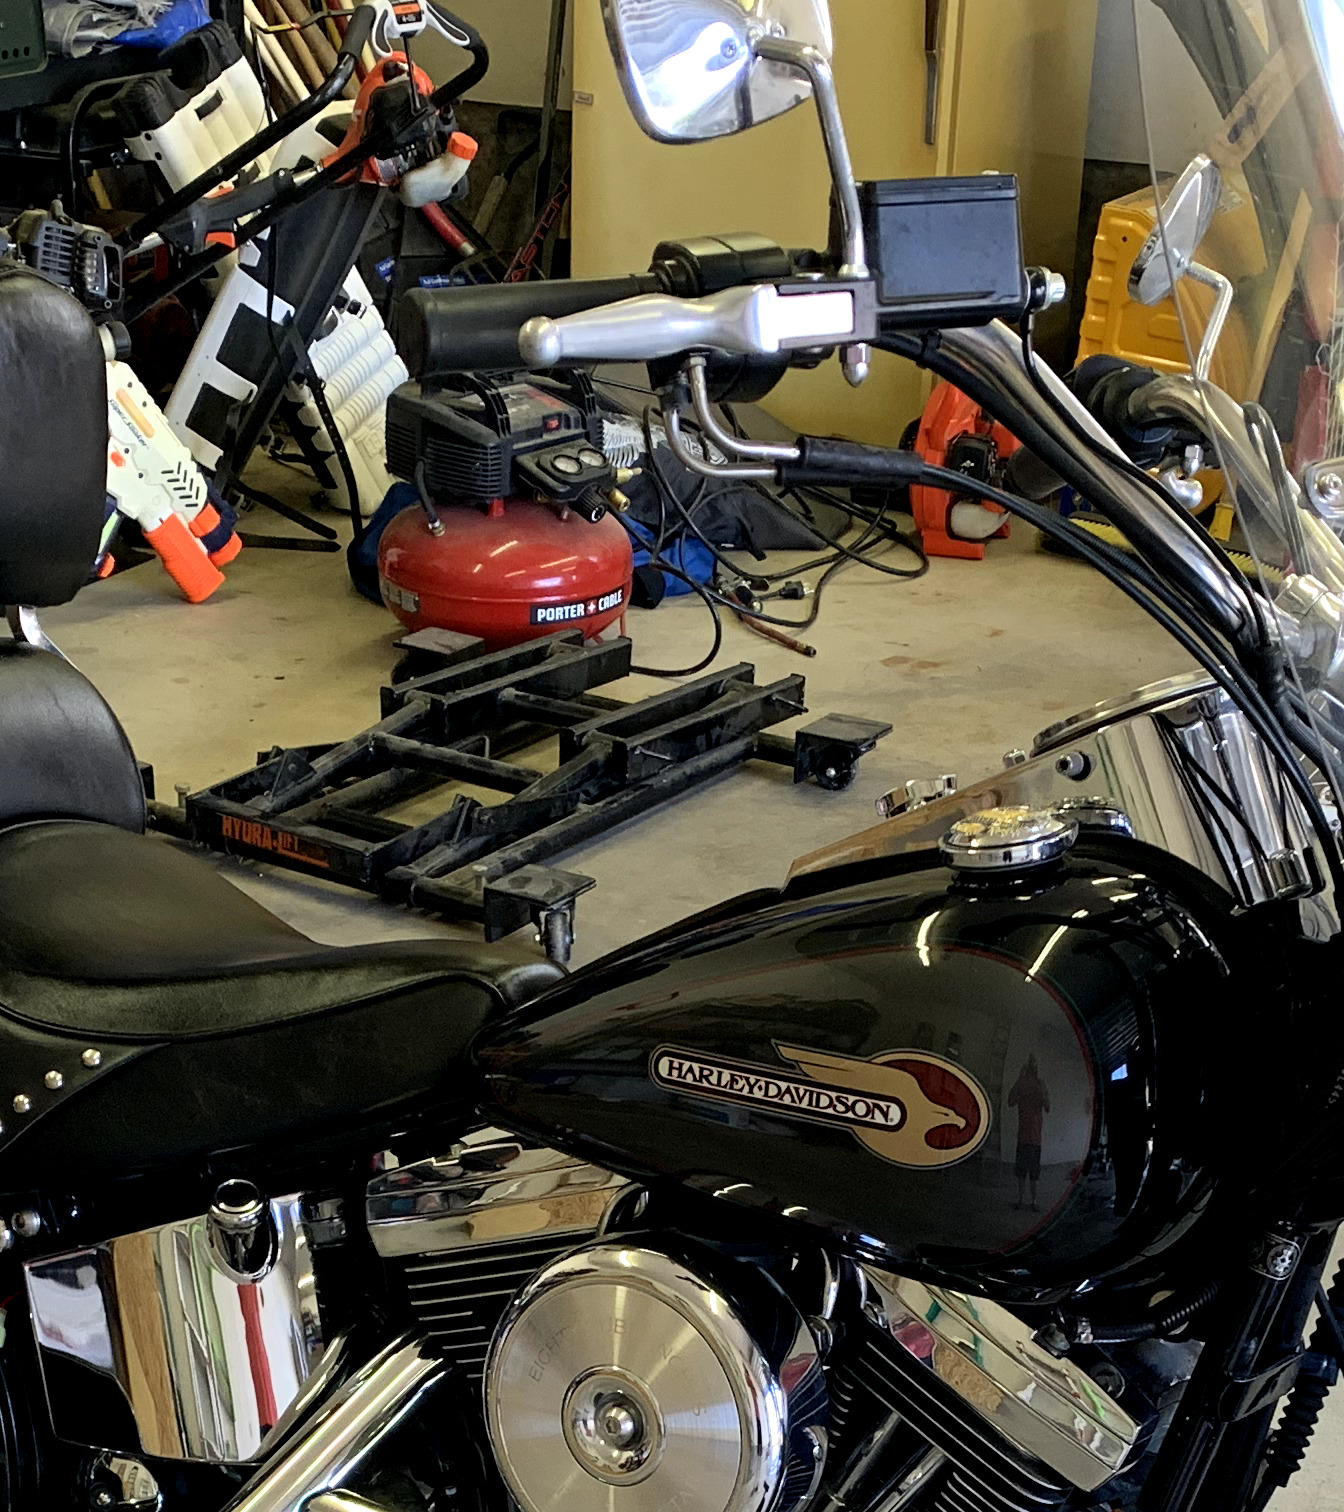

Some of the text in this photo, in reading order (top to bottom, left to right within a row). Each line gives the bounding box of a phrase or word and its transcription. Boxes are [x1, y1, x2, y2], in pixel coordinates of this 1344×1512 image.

[512, 182, 570, 284] ASTON
[537, 589, 623, 622] PORTER CABLE
